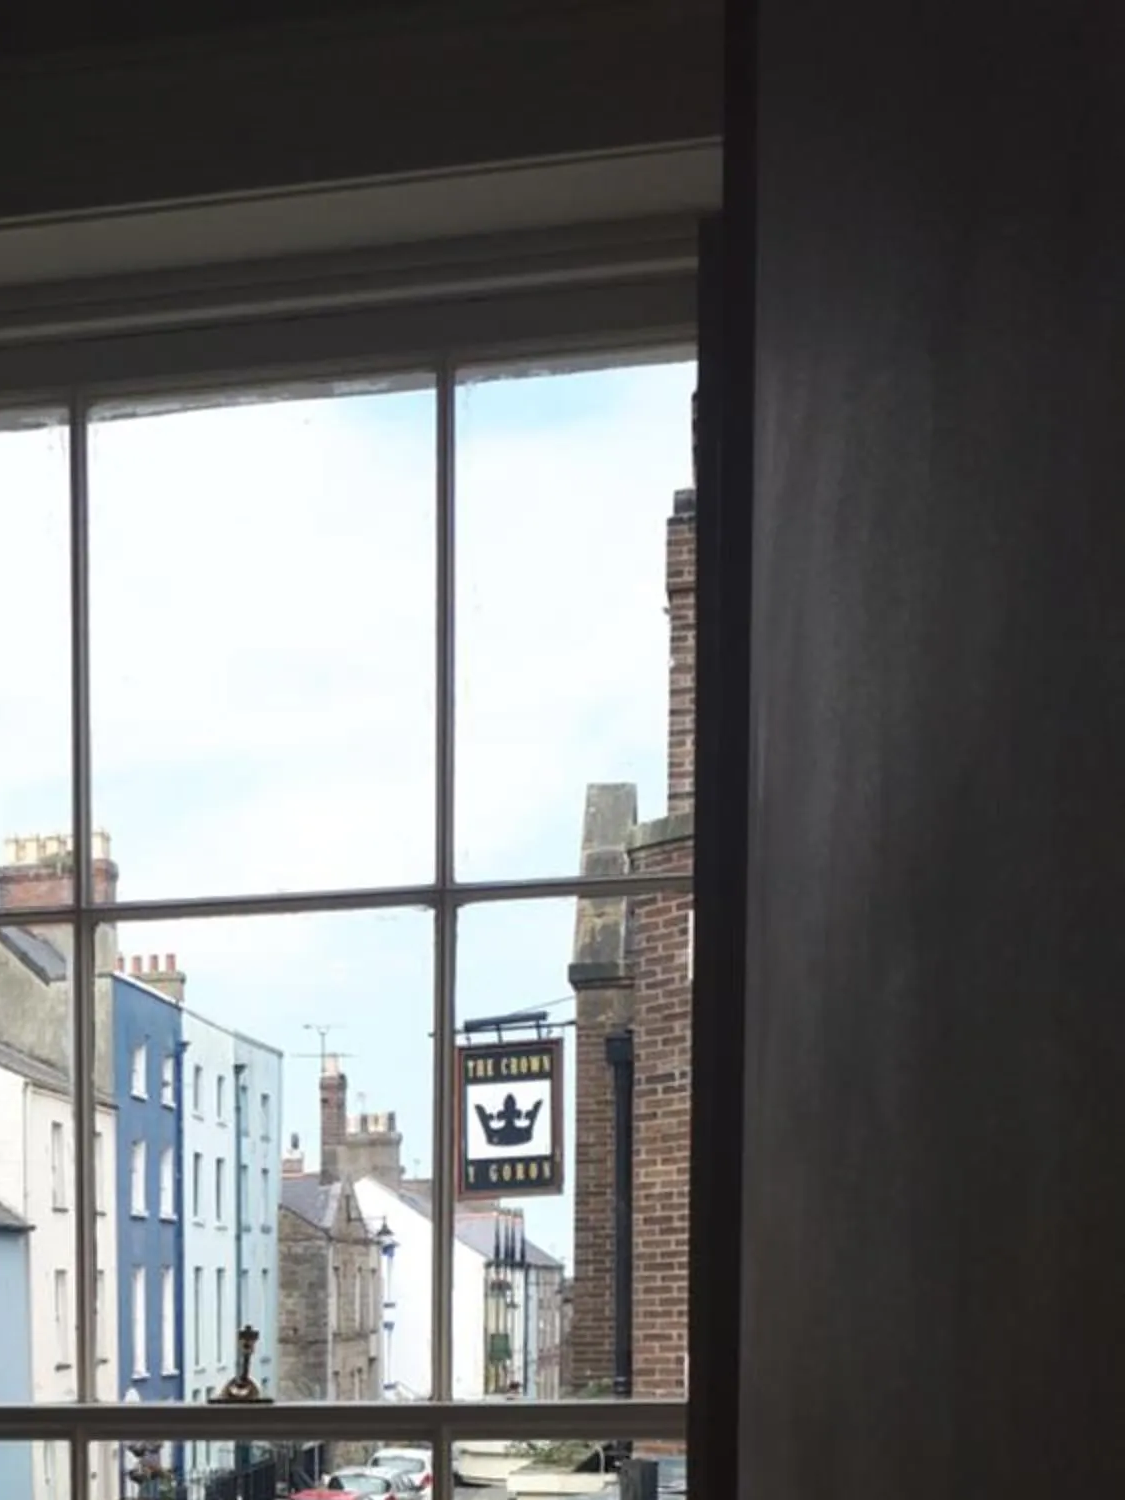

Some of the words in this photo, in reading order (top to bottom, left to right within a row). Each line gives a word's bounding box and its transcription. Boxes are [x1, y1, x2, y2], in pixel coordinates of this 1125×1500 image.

[467, 1057, 494, 1078] THE
[500, 1055, 552, 1076] CROWN
[488, 1161, 552, 1184] GORON
